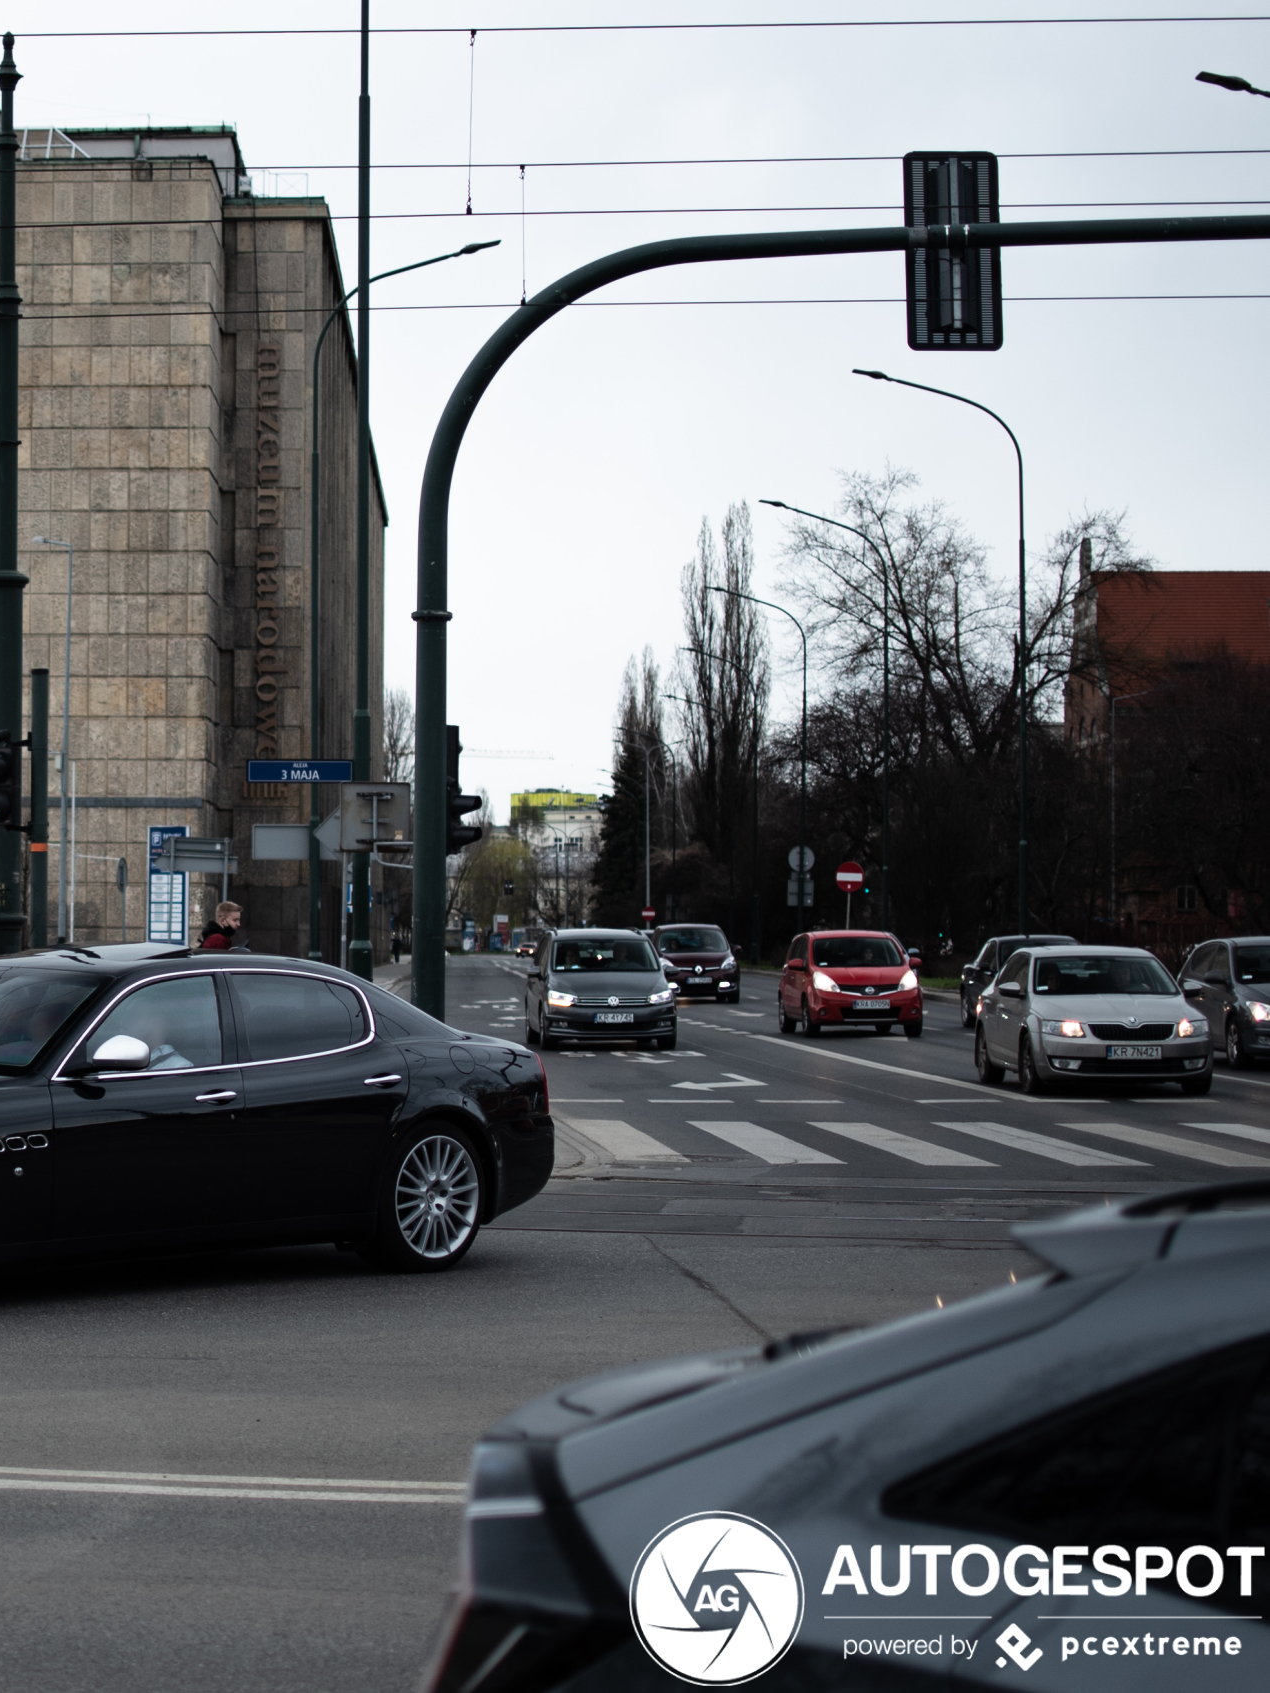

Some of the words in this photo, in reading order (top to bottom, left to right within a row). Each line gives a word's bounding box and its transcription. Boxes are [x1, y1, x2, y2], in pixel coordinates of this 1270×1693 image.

[256, 341, 280, 527] muzeum
[255, 544, 289, 759] narodowe
[281, 770, 288, 780] 3
[290, 770, 320, 780] MAJA
[1113, 1047, 1128, 1057] KR
[1130, 1047, 1159, 1057] 7N421
